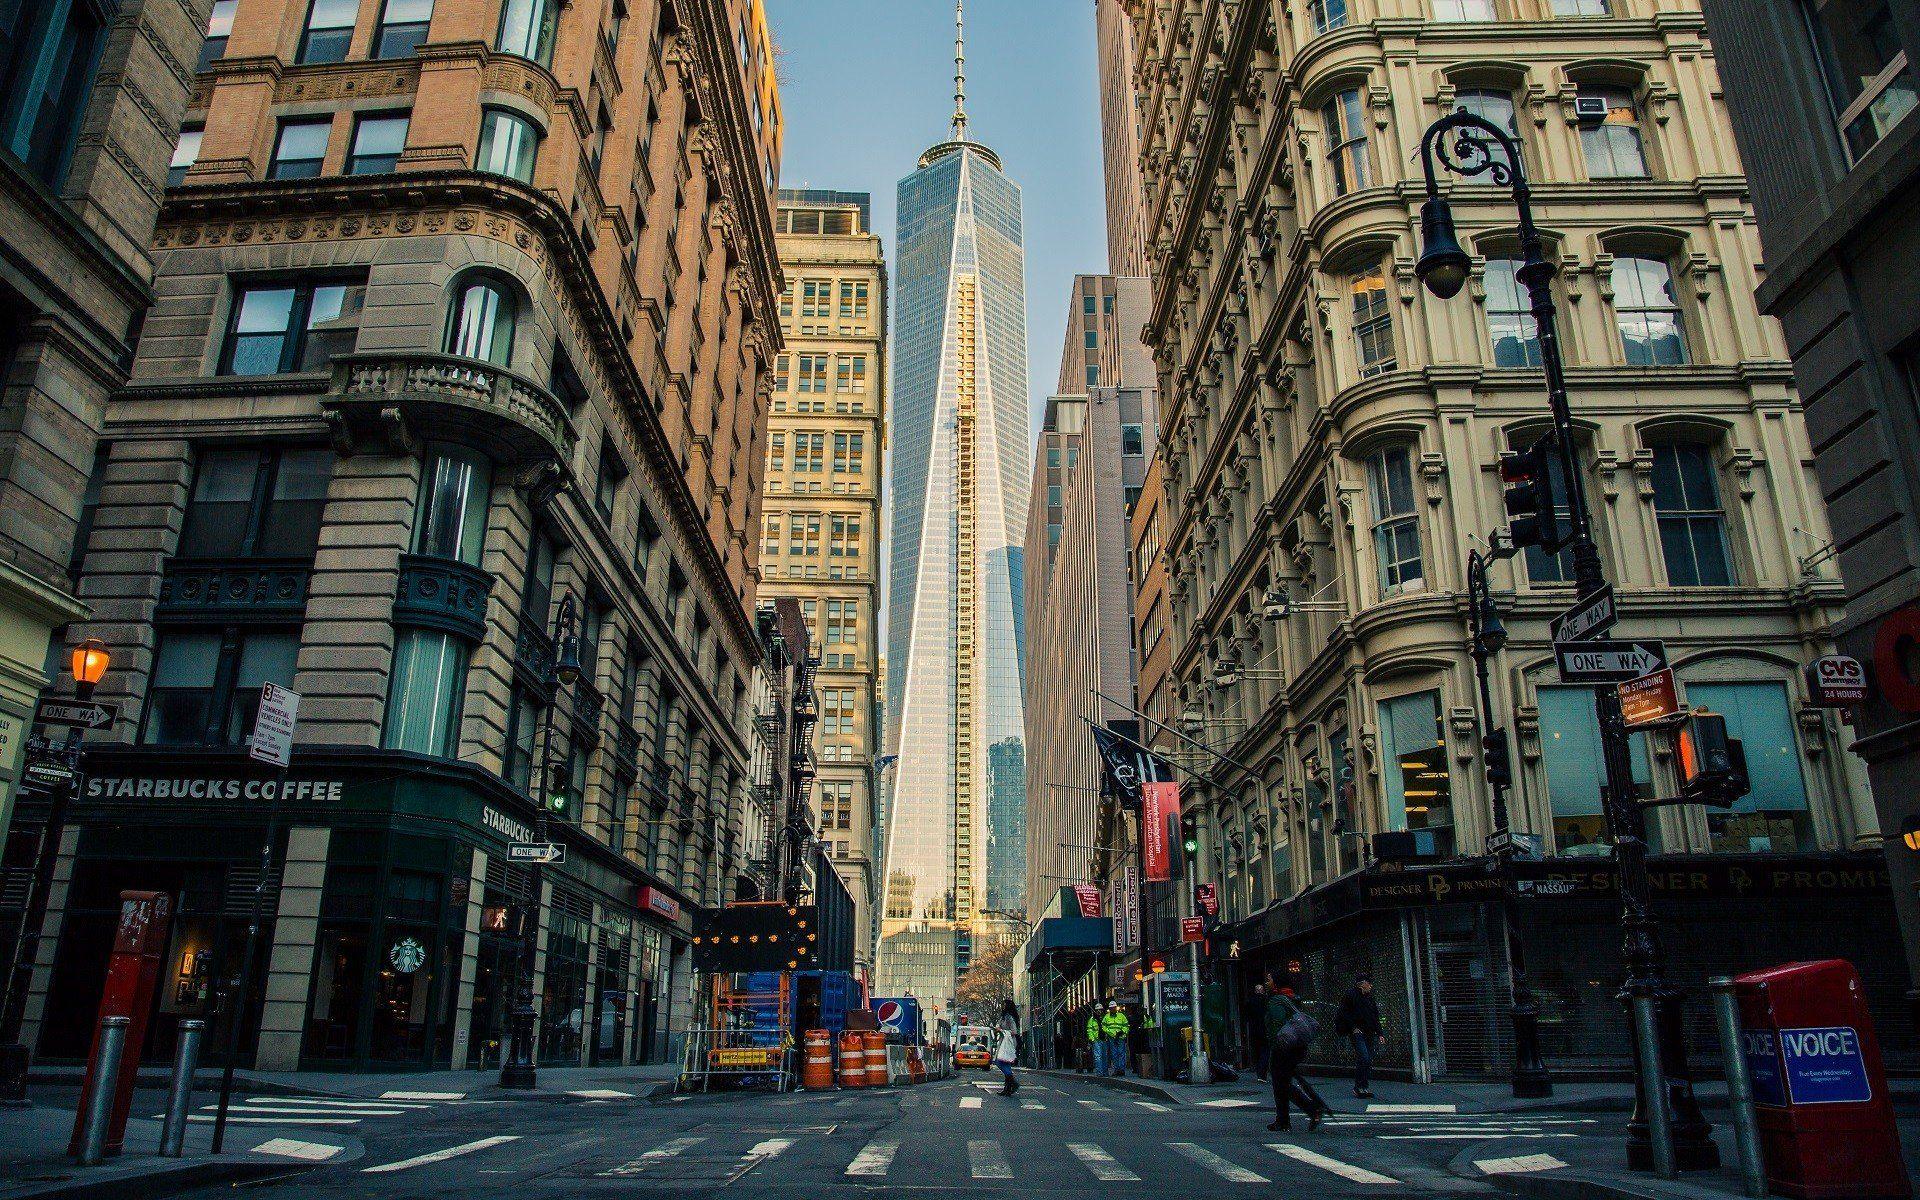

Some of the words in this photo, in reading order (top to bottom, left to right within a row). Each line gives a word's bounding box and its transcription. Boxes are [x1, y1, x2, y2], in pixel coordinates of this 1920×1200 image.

[1561, 622, 1580, 641] ONE
[1586, 601, 1606, 626] WAY
[1573, 654, 1605, 670] ONE
[1617, 653, 1650, 670] WAY
[1820, 660, 1861, 677] CVS
[1620, 685, 1631, 695] NO
[1632, 675, 1664, 691] STANDING
[1823, 678, 1861, 686] pharmacy
[264, 685, 273, 699] 3
[1824, 690, 1836, 699] 24
[1837, 690, 1863, 699] HOURS
[47, 706, 69, 718] ONE
[79, 709, 105, 720] WAY
[87, 778, 242, 799] STARBUCKS
[244, 780, 342, 801] COFFEE
[482, 805, 532, 845] STARBUCKS
[516, 848, 533, 857] ONE
[539, 849, 557, 857] WAY
[1128, 867, 1136, 909] Roberts
[1535, 883, 1569, 894] NASSAU
[1548, 872, 1709, 891] ESINER
[1369, 885, 1422, 896] DESIGNER
[1788, 1032, 1856, 1057] VOICE
